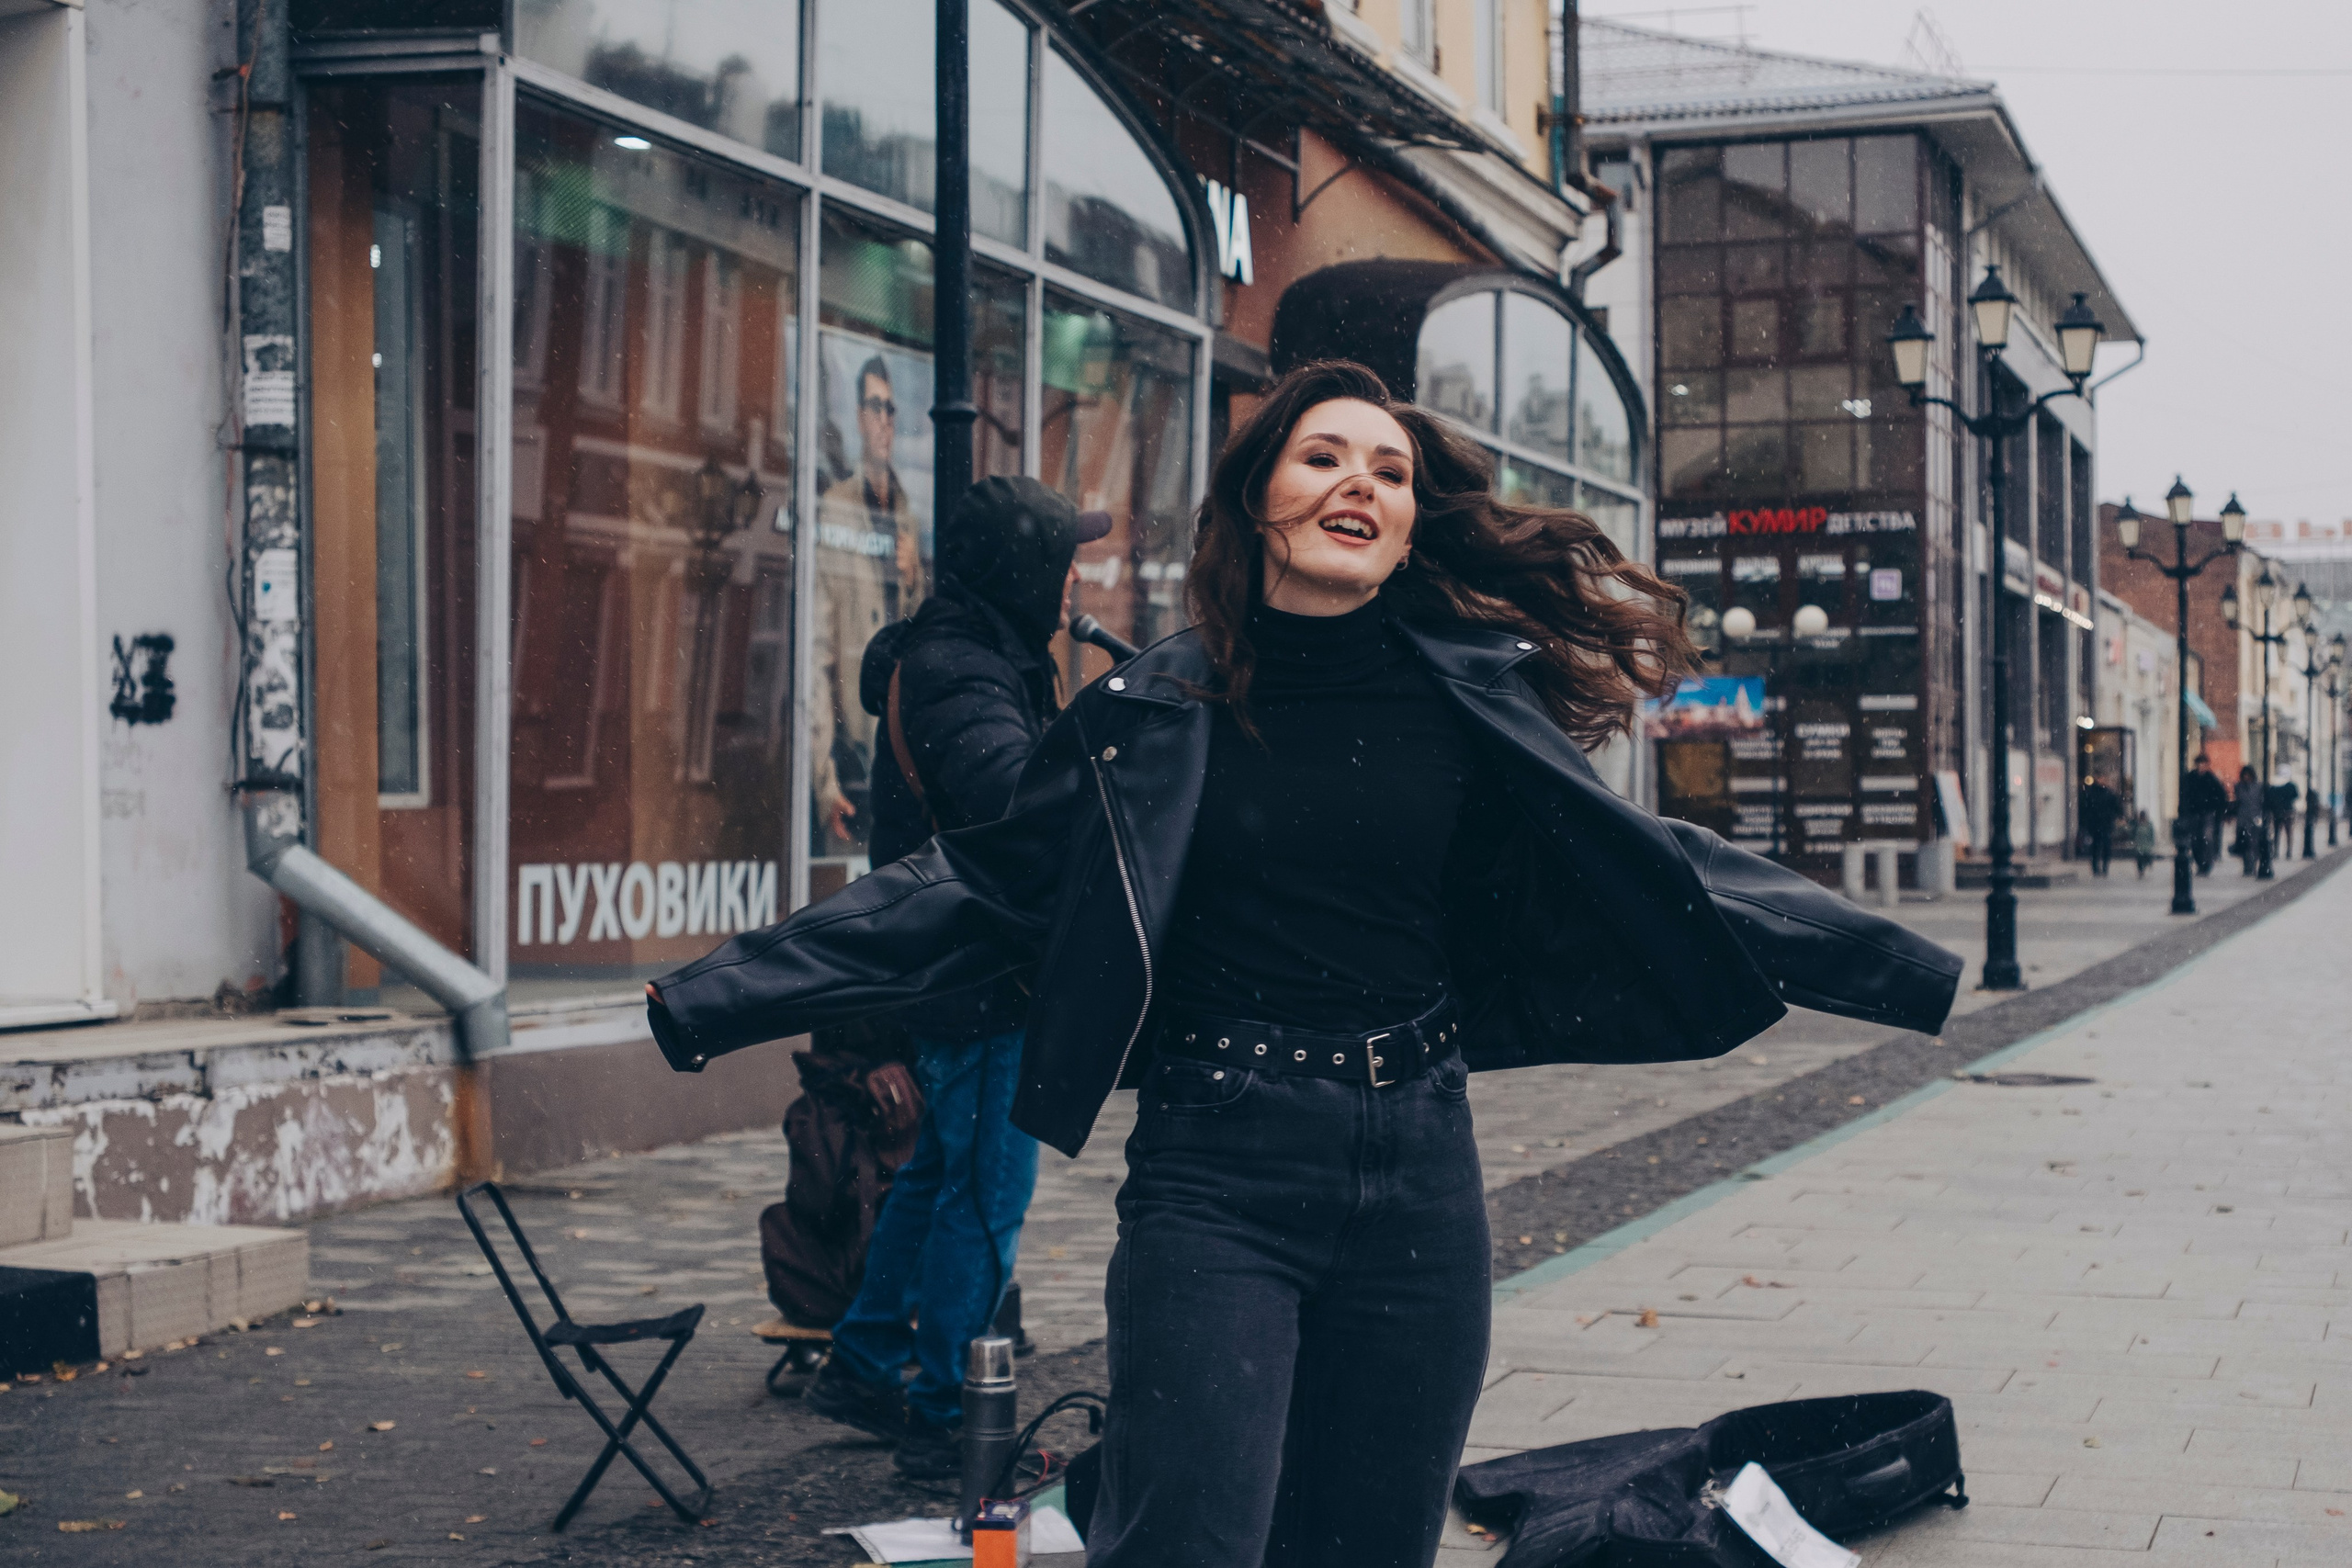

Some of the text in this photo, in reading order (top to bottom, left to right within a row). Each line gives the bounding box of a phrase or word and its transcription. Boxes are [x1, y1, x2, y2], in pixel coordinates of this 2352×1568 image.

[1729, 507, 1826, 535] КУМИР
[1827, 512, 1917, 534] ДЕТСТВА
[518, 862, 777, 944] ПУХОВИКИ
